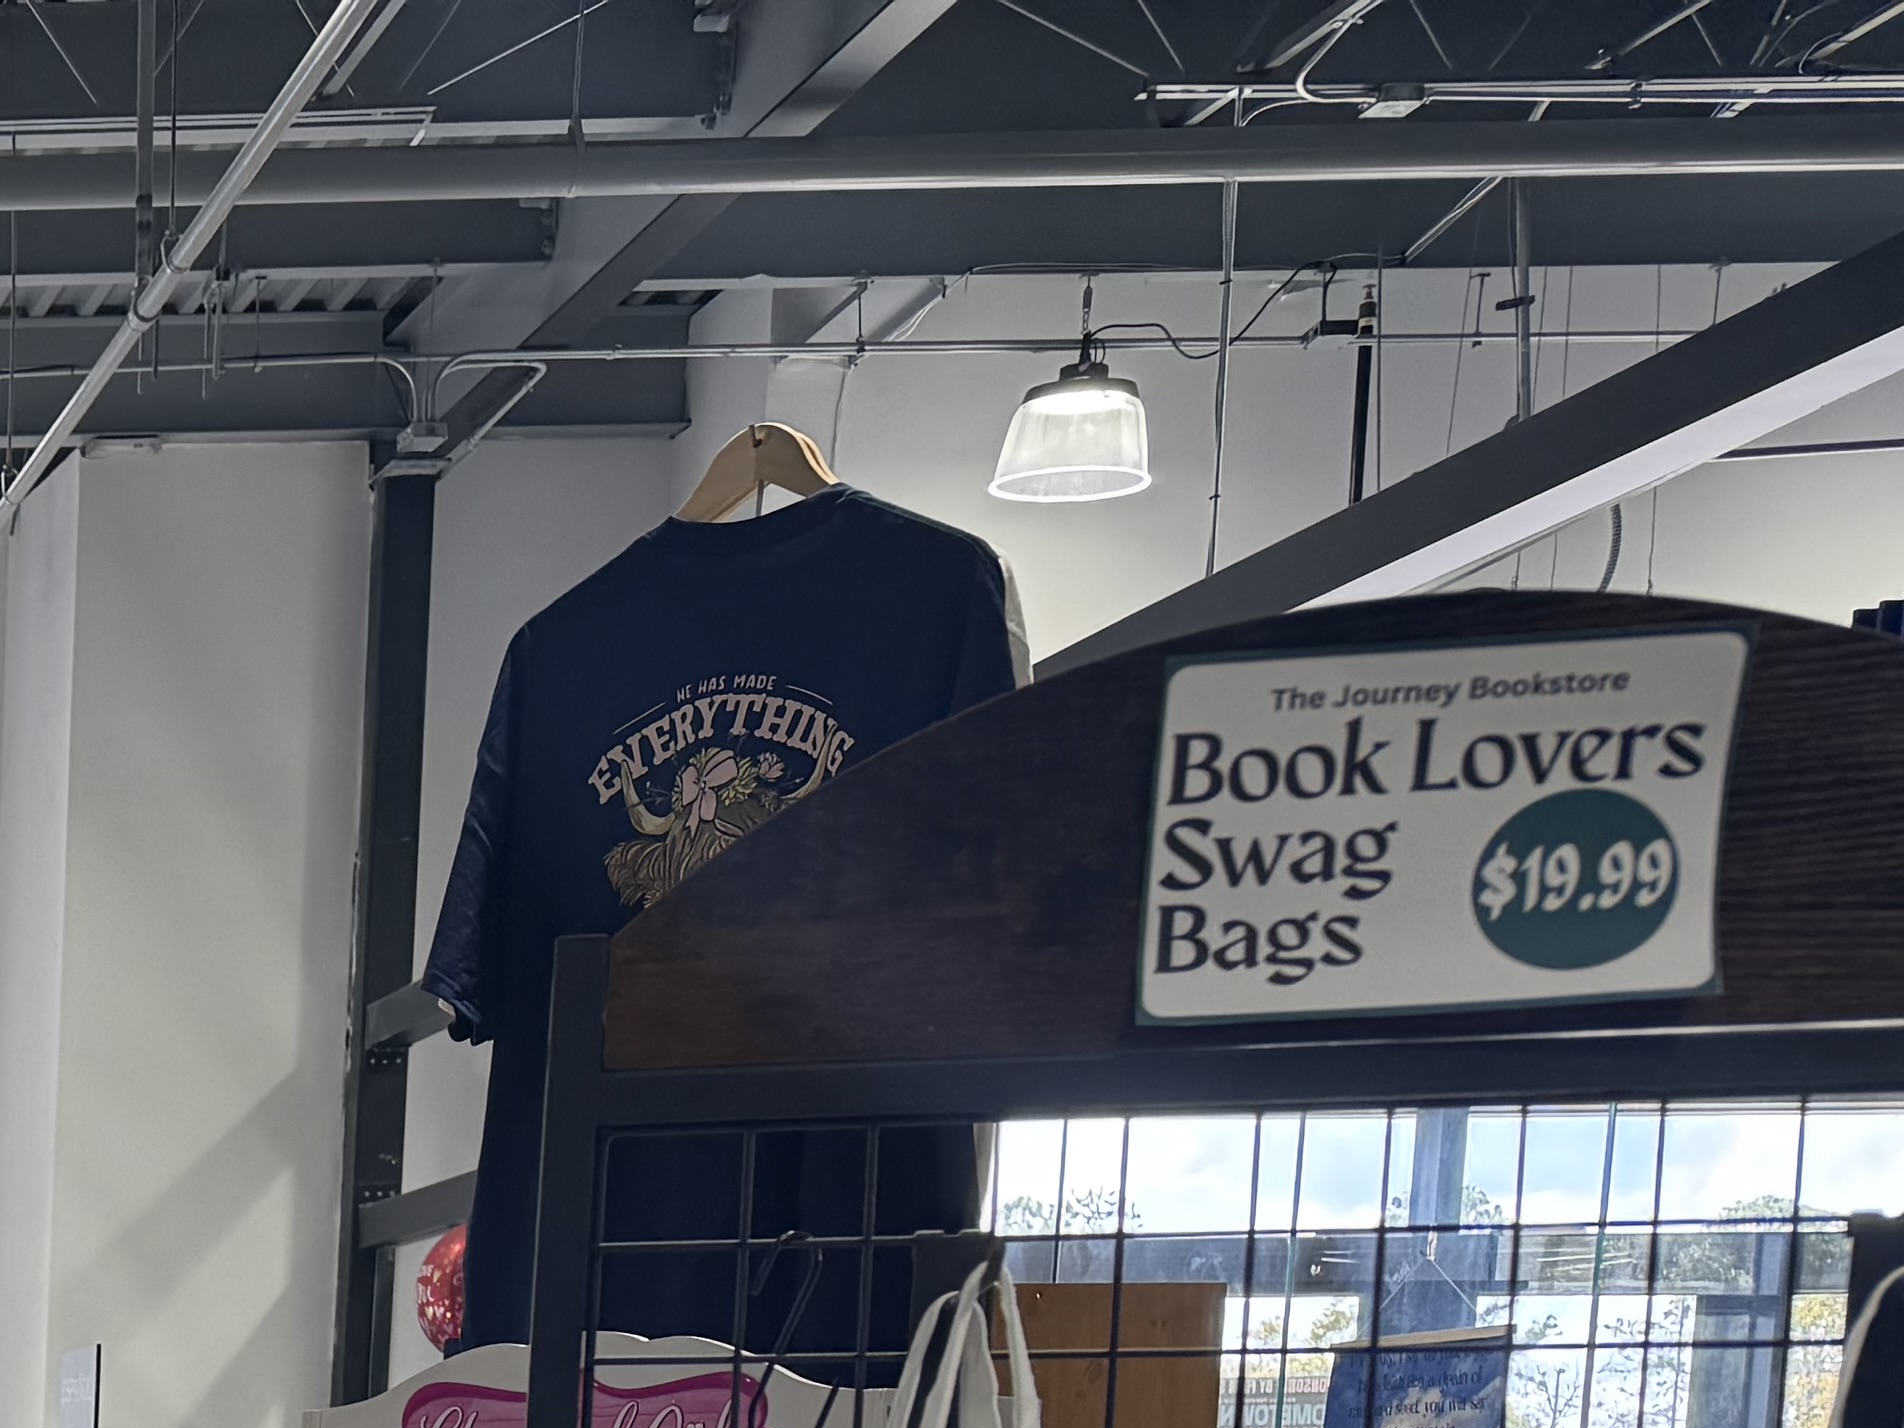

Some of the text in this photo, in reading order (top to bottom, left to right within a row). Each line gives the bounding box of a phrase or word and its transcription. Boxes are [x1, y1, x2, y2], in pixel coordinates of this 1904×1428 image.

[677, 674, 777, 702] HE HAS MADE
[1272, 668, 1630, 712] The Journey Bookstore
[588, 693, 855, 805] EVERYTHING
[1168, 716, 1707, 805] Book Lovers
[1159, 817, 1399, 899] Swag
[1478, 838, 1673, 921] $19.99
[1153, 903, 1364, 985] Bags
